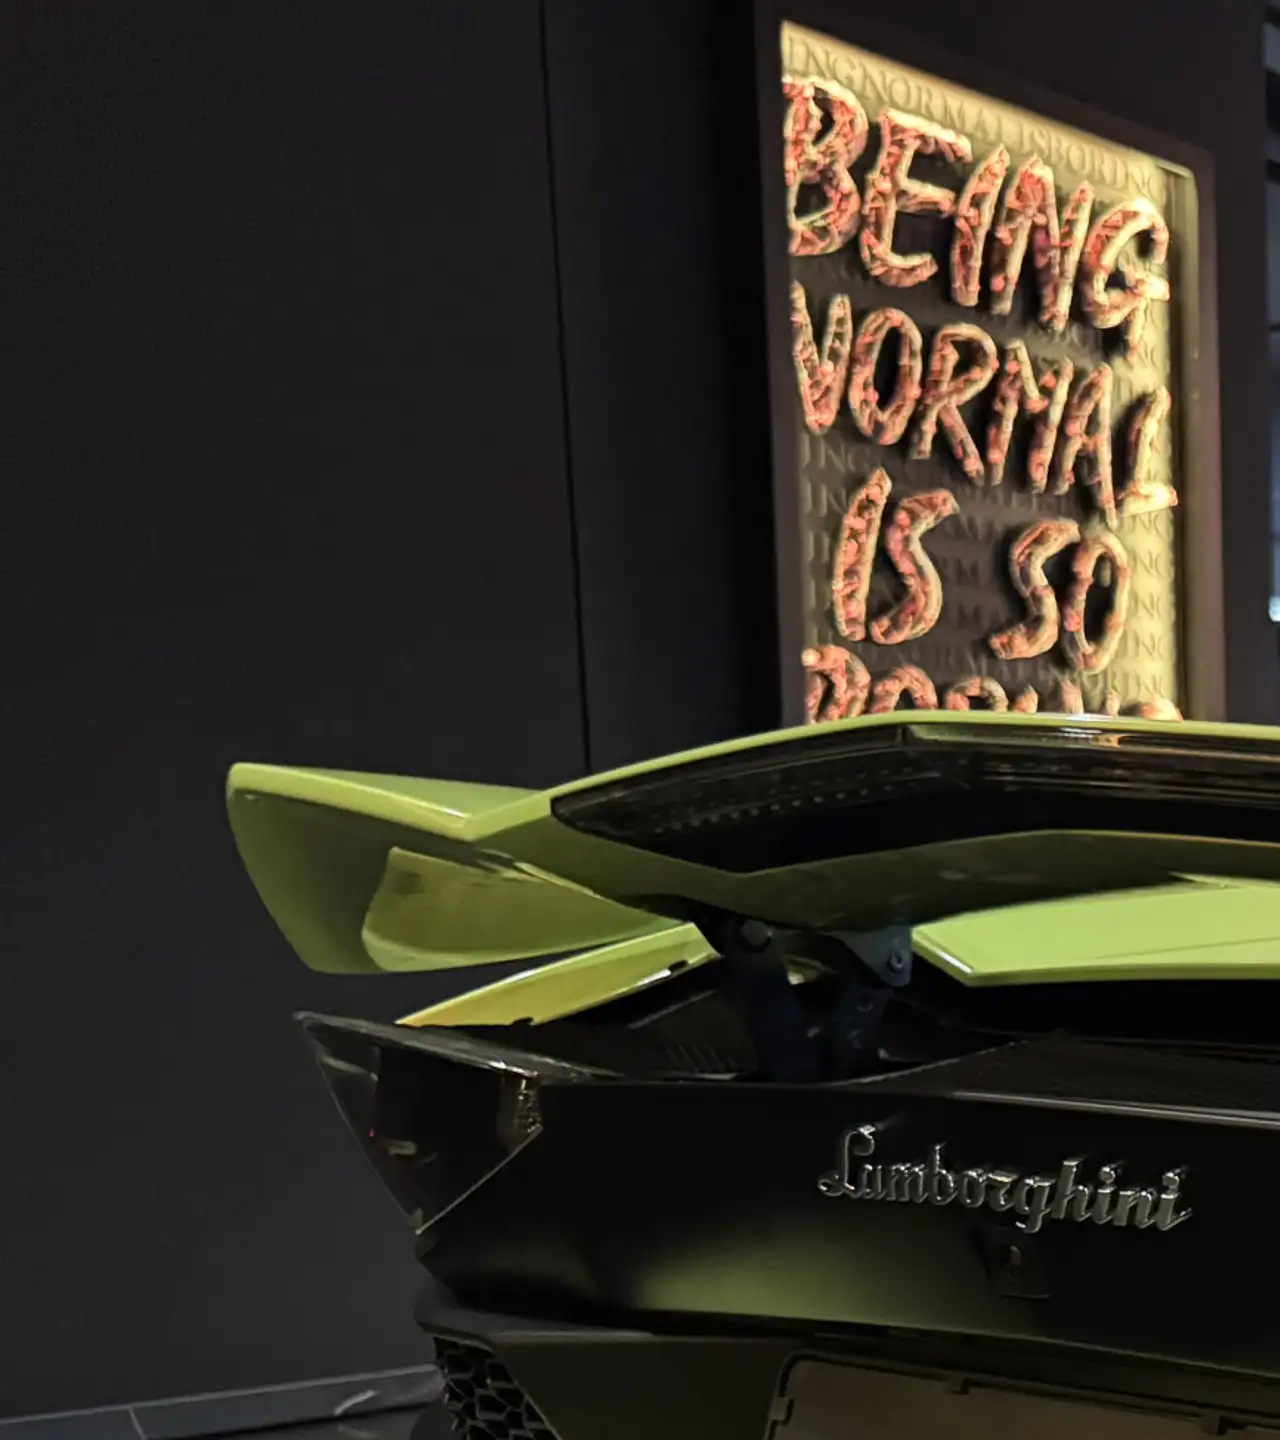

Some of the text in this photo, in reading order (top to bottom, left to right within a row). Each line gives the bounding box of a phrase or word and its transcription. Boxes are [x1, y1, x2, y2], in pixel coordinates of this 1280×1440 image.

[783, 73, 1170, 362] BEING
[832, 467, 961, 645] IS
[990, 517, 1131, 675] SO
[817, 1124, 1192, 1233] Lamborghini
